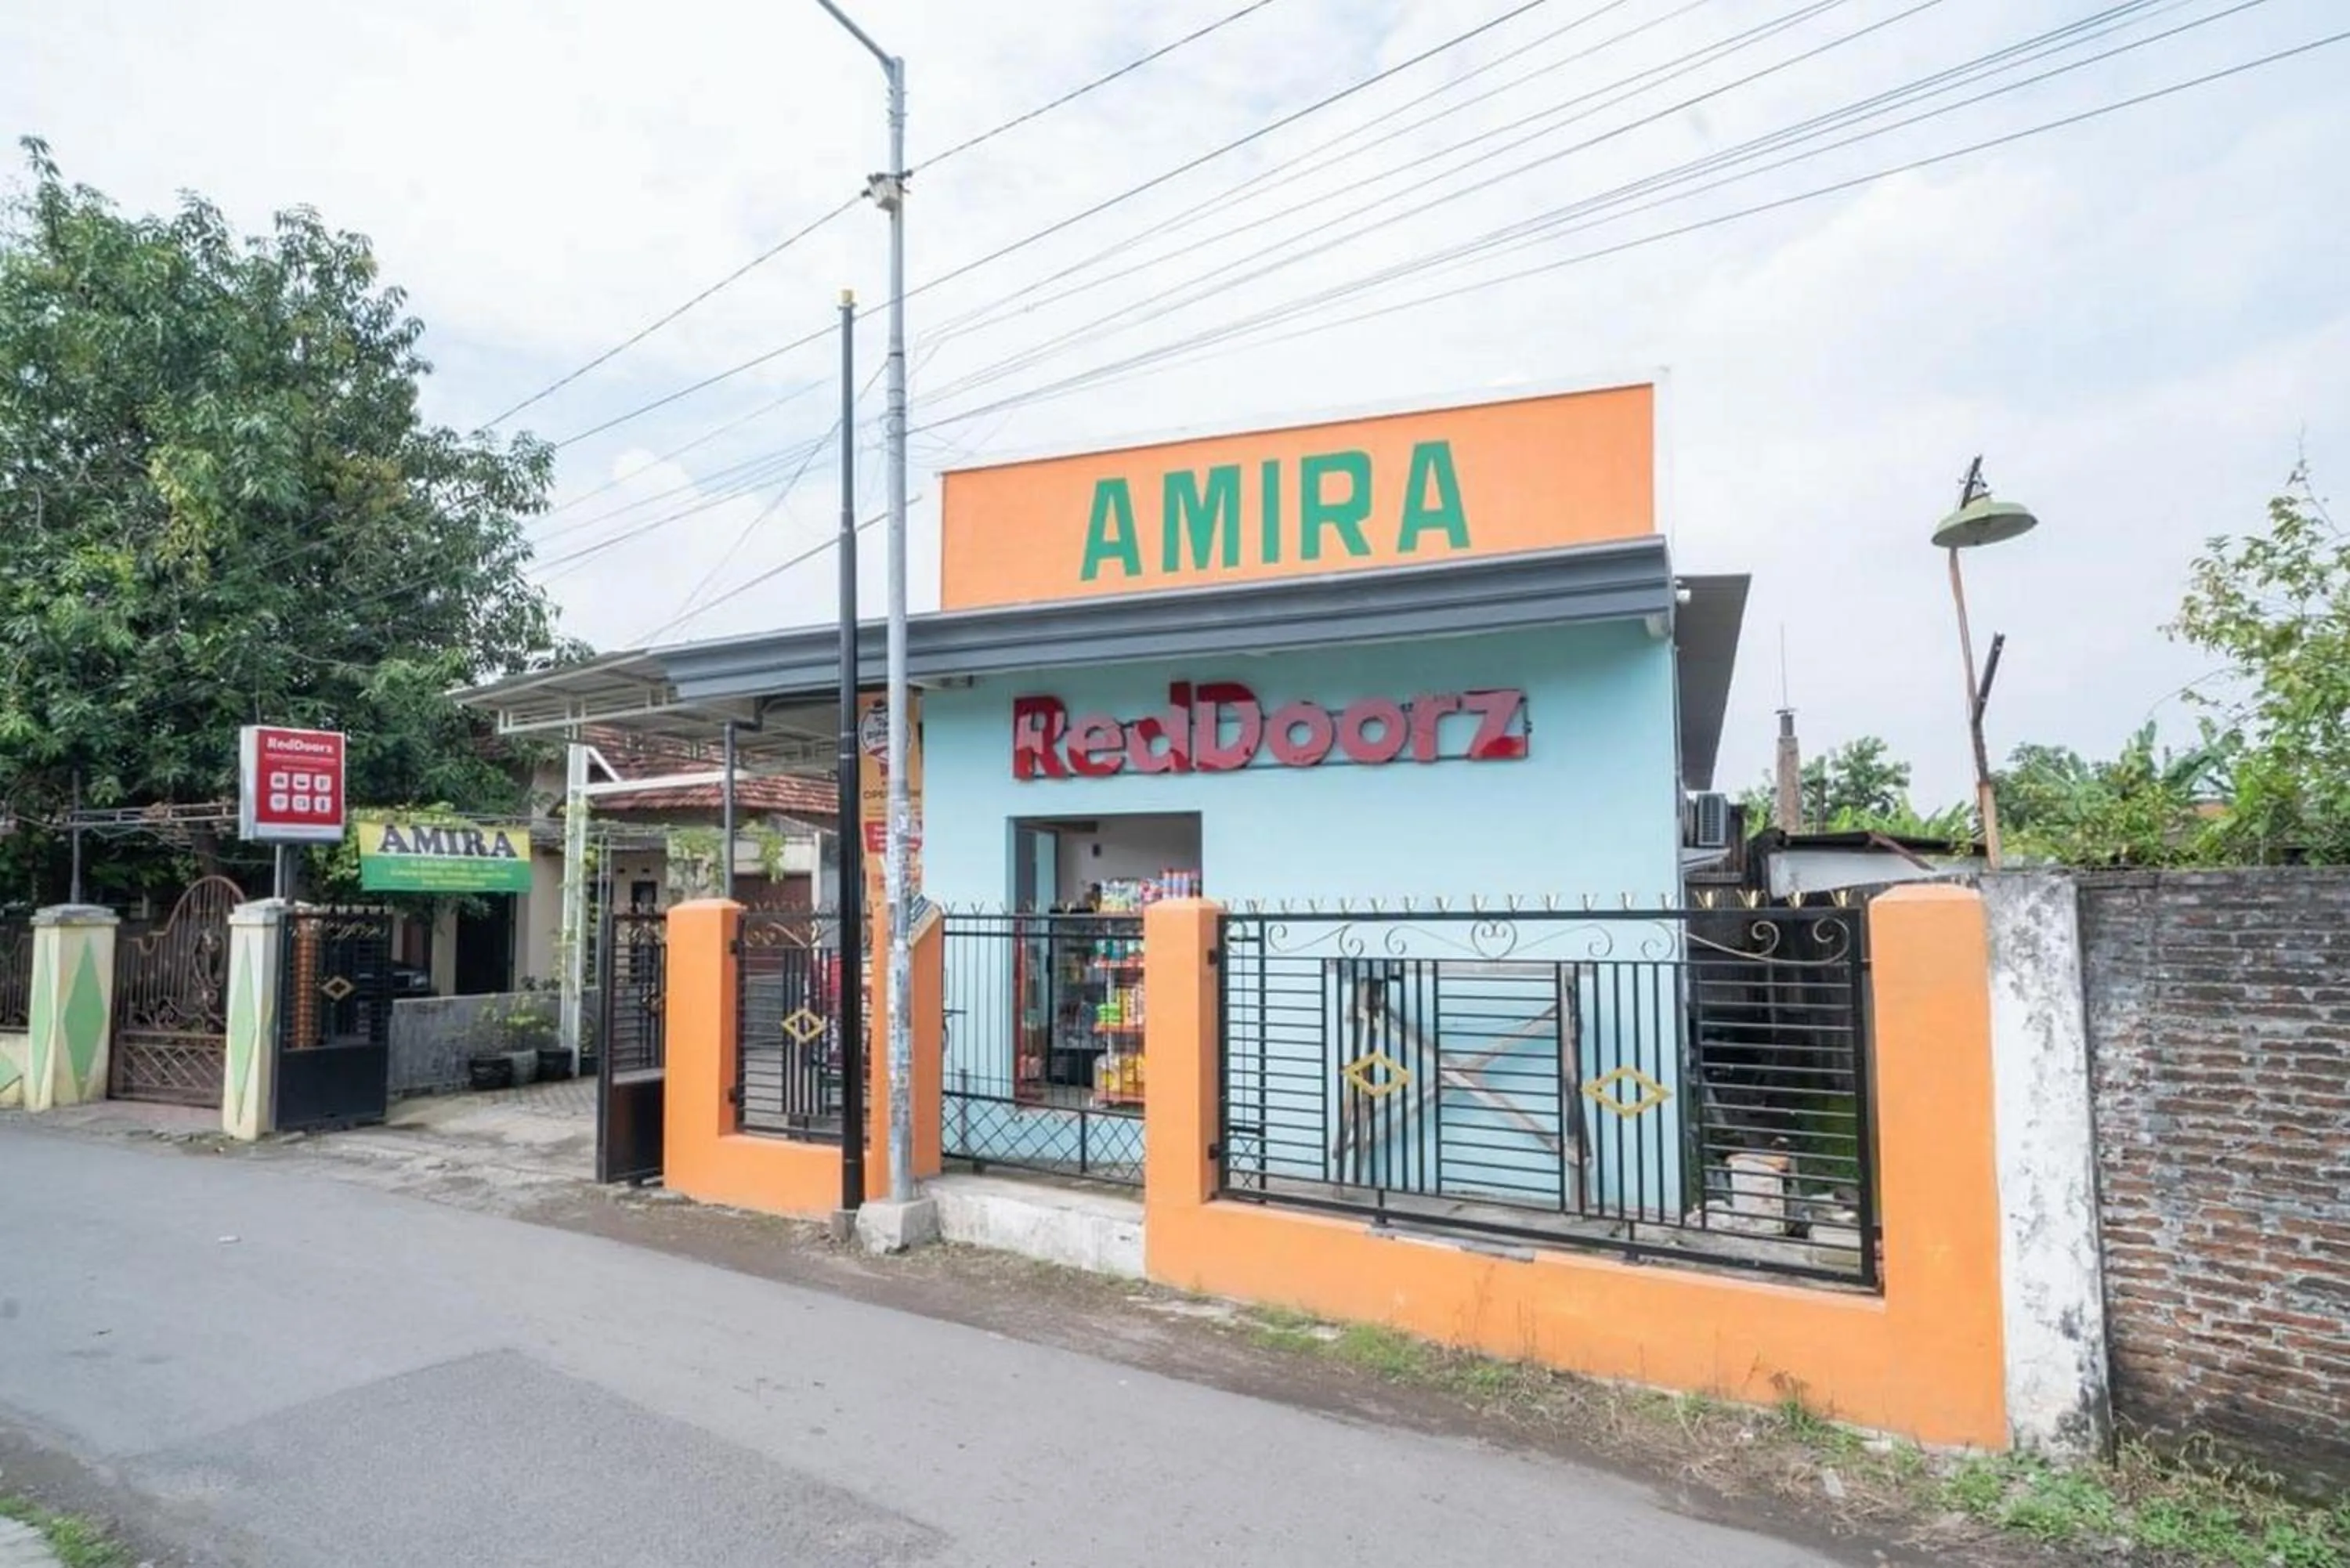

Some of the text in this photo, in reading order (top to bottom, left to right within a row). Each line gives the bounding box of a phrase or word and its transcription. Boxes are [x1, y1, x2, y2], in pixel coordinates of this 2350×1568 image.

[1079, 439, 1471, 581] AMIRA
[1014, 680, 1527, 780] RedDoorz
[378, 824, 518, 858] AMIRA
